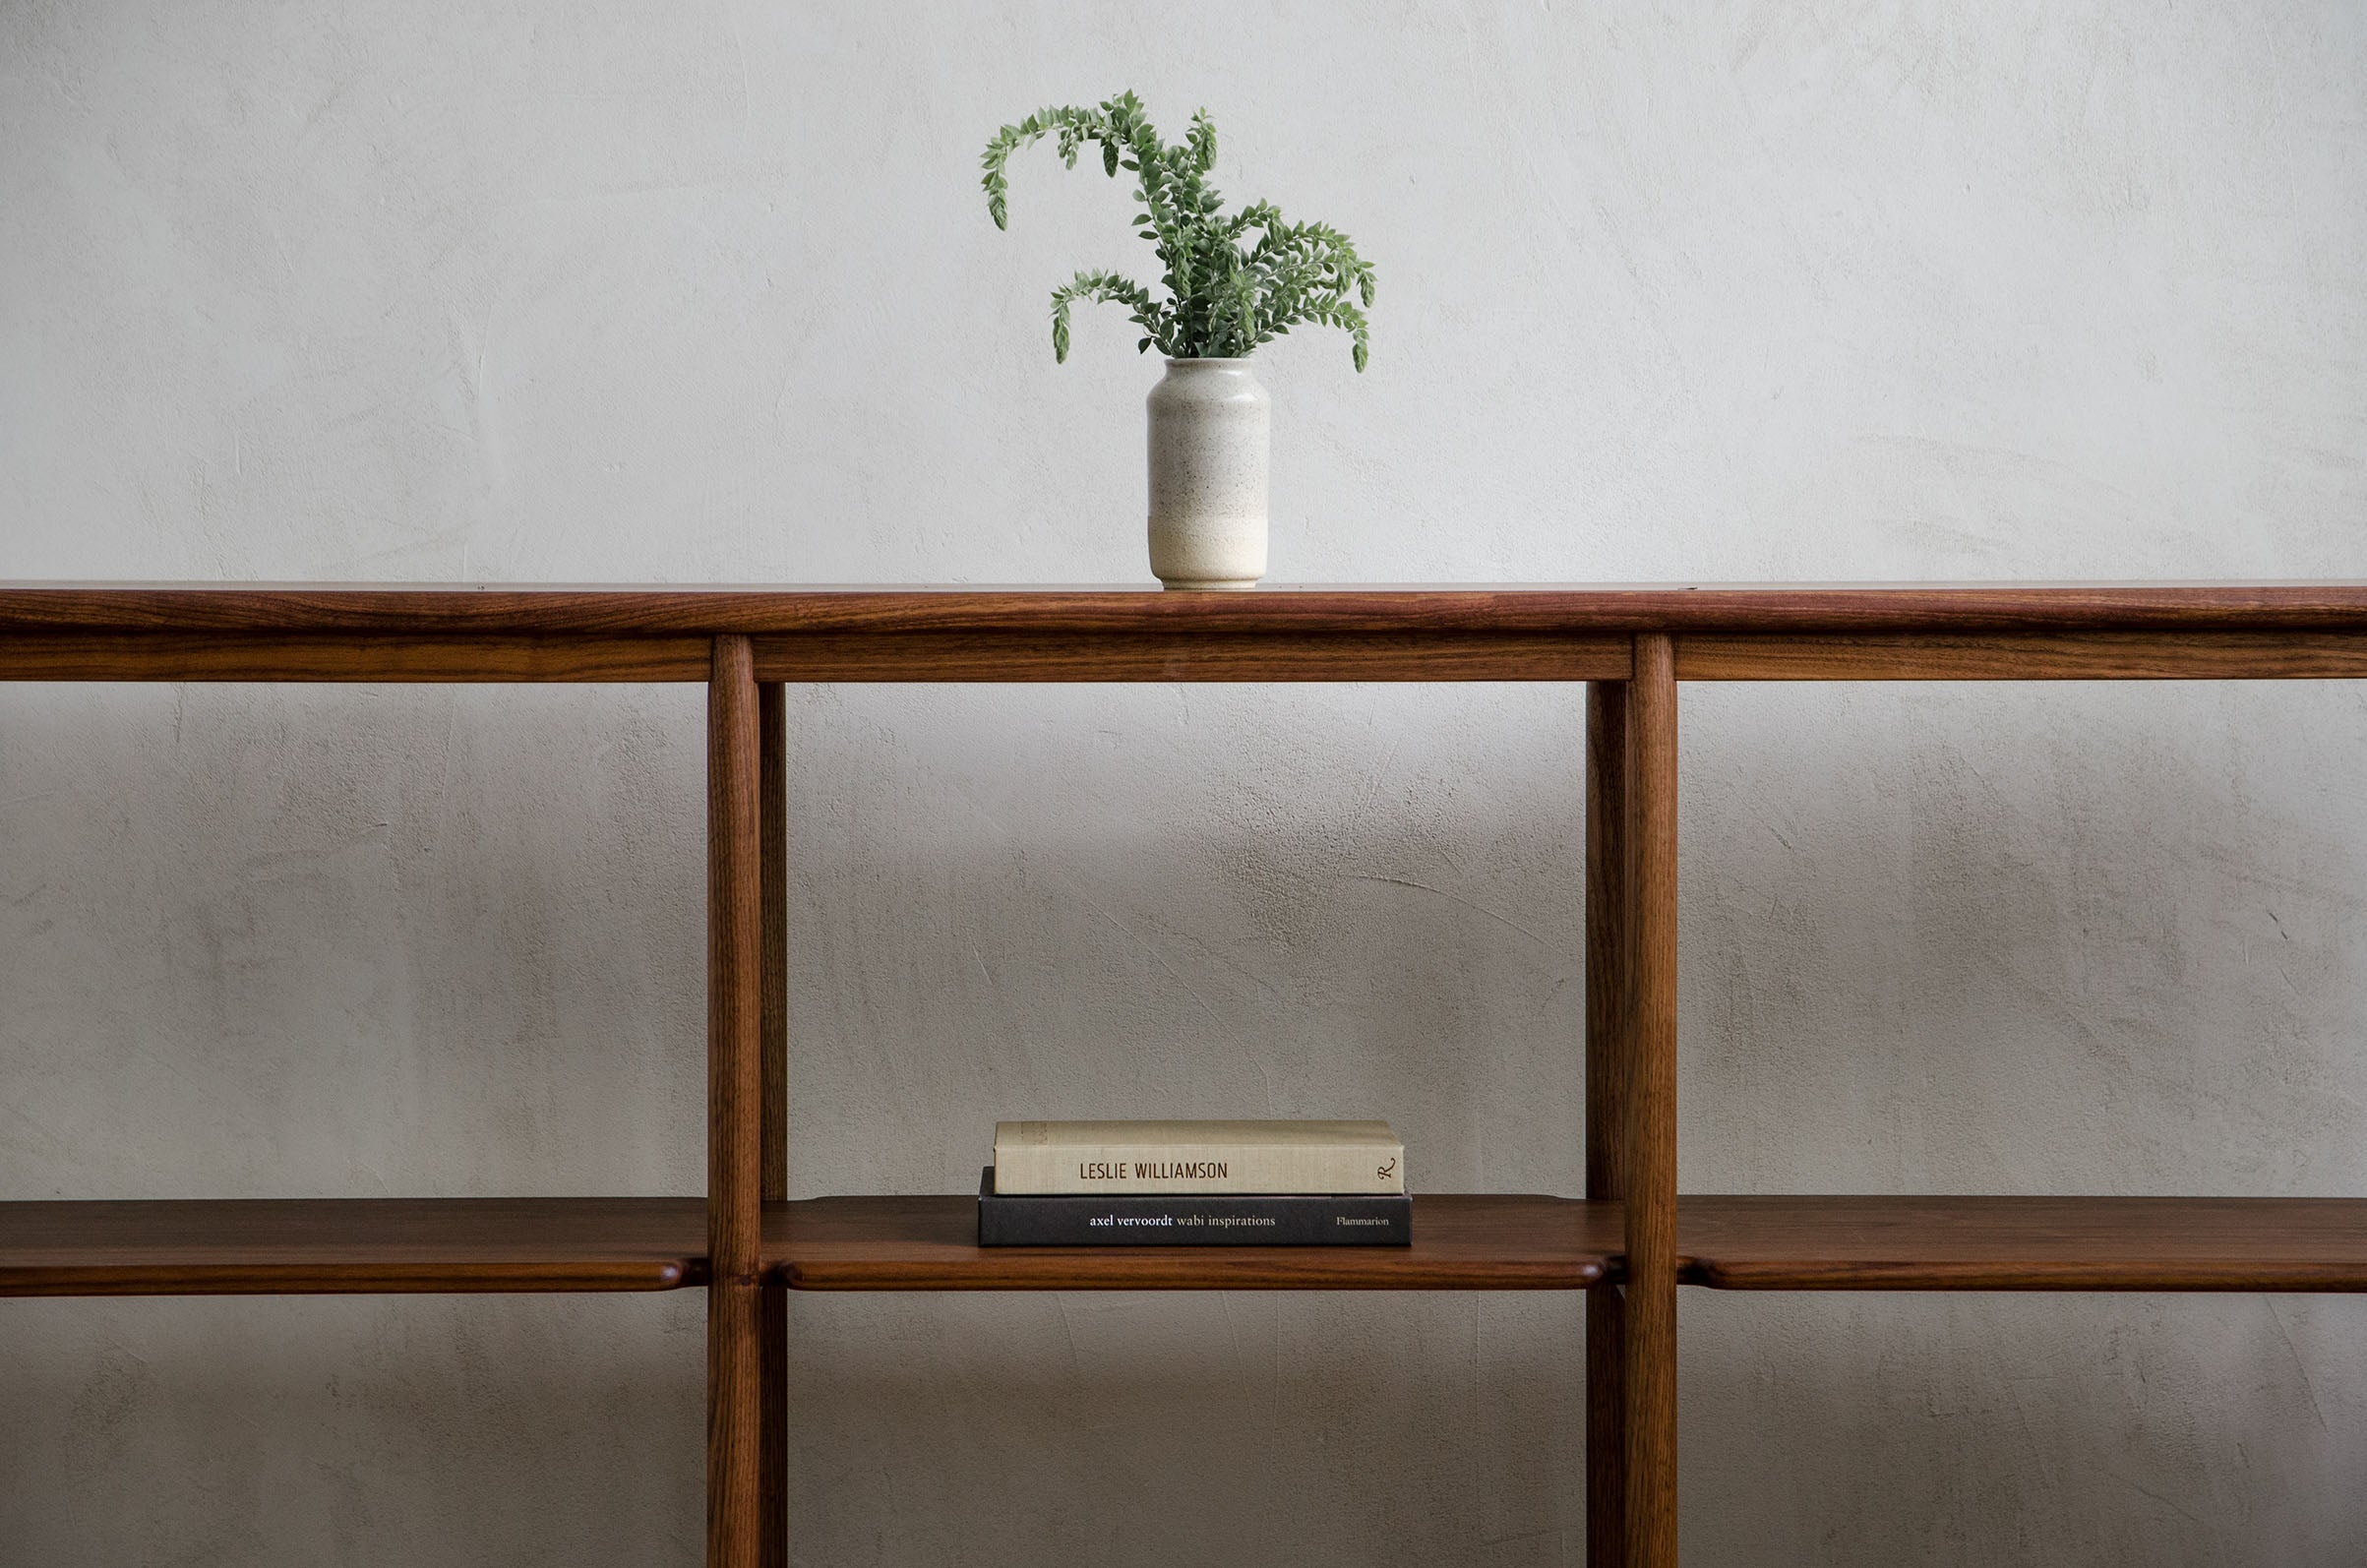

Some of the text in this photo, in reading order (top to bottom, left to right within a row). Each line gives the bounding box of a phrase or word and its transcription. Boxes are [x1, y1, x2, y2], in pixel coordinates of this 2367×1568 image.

[1080, 1162, 1228, 1179] LESLIE WILLIAMSON
[1089, 1214, 1276, 1229] axel vervoordt wabi inspirations
[1336, 1216, 1389, 1226] Flammarion
